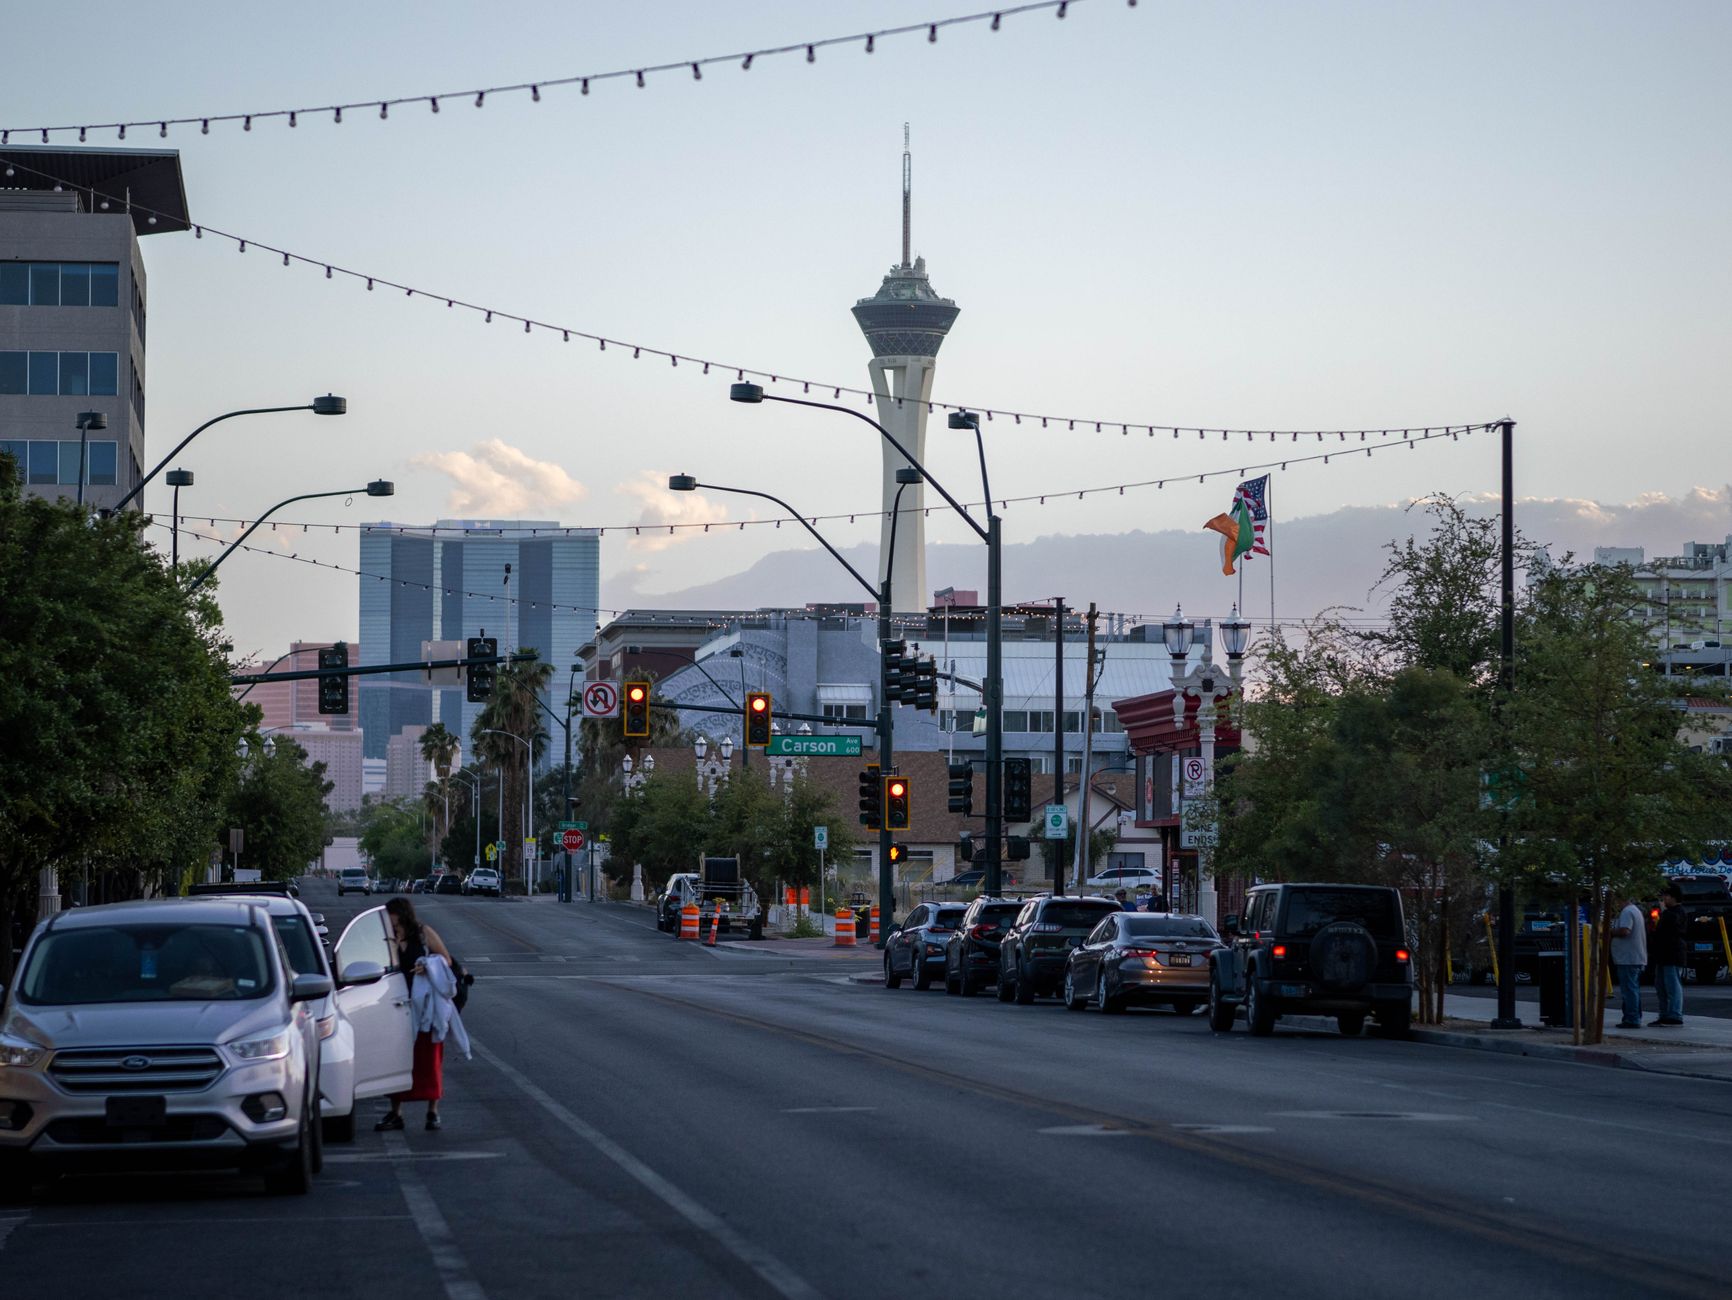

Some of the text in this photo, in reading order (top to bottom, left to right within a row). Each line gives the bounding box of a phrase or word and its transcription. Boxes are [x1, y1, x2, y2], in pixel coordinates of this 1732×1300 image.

[781, 738, 836, 752] Carson
[563, 835, 582, 844] STOP
[1188, 835, 1213, 844] ENDS
